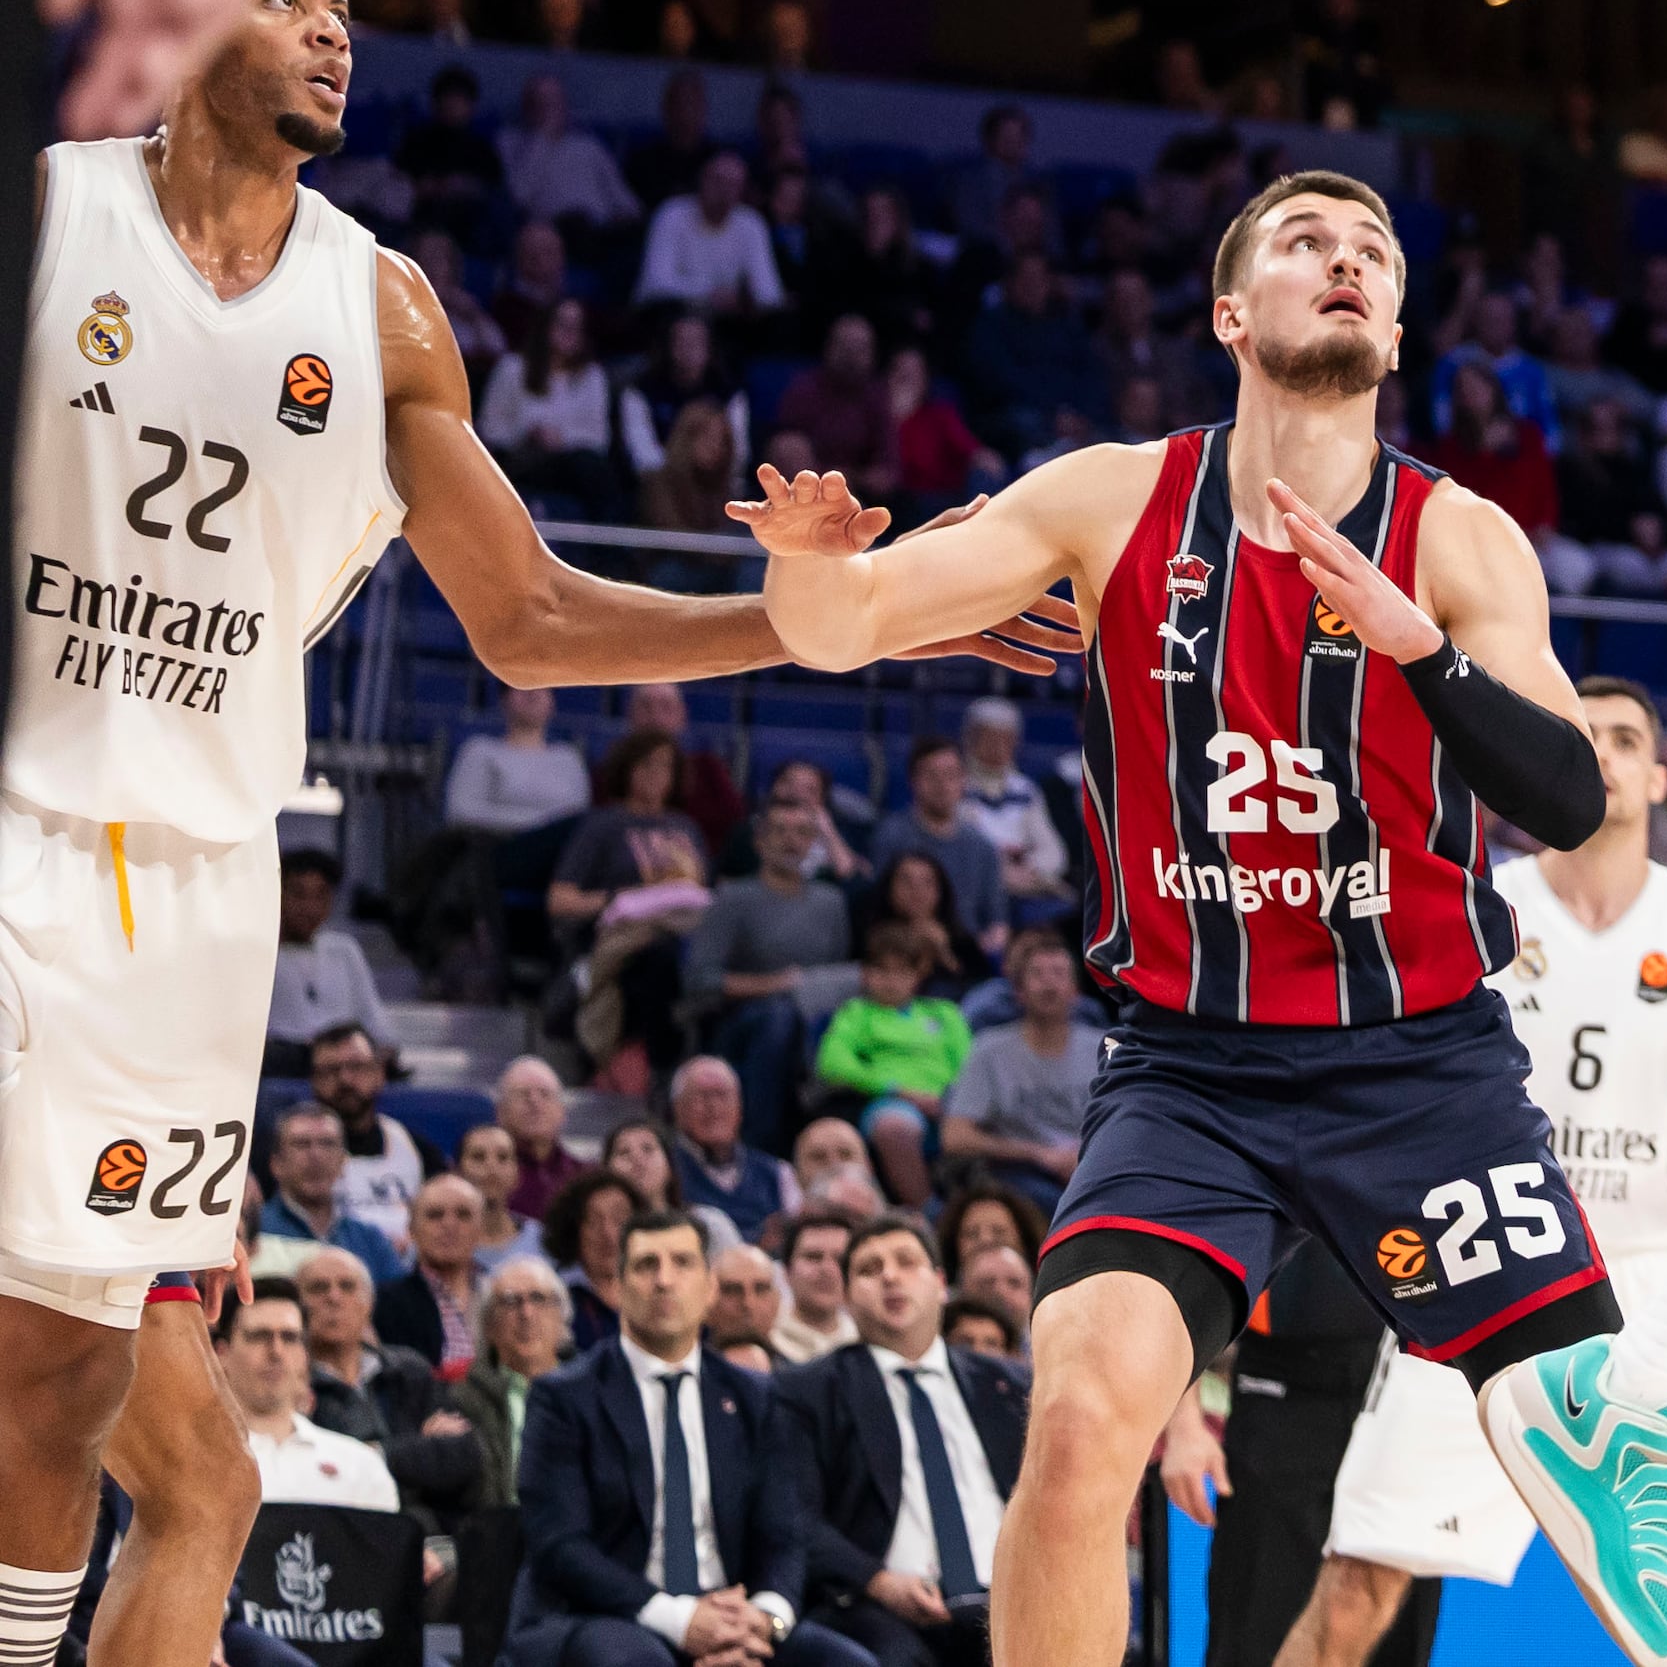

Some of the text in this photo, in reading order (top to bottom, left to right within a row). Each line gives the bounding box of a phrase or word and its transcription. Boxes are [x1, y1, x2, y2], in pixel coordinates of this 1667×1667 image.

[126, 425, 250, 554] 22
[25, 553, 265, 657] Emirates
[55, 634, 229, 715] FLY BETTER
[1309, 645, 1358, 658] abu dhabi
[1206, 731, 1340, 834] 25
[1152, 847, 1391, 918] kingroyal
[1568, 1023, 1608, 1092] 6
[150, 1120, 247, 1219] 22
[1421, 1161, 1567, 1286] 25
[242, 1599, 385, 1643] Emirates
